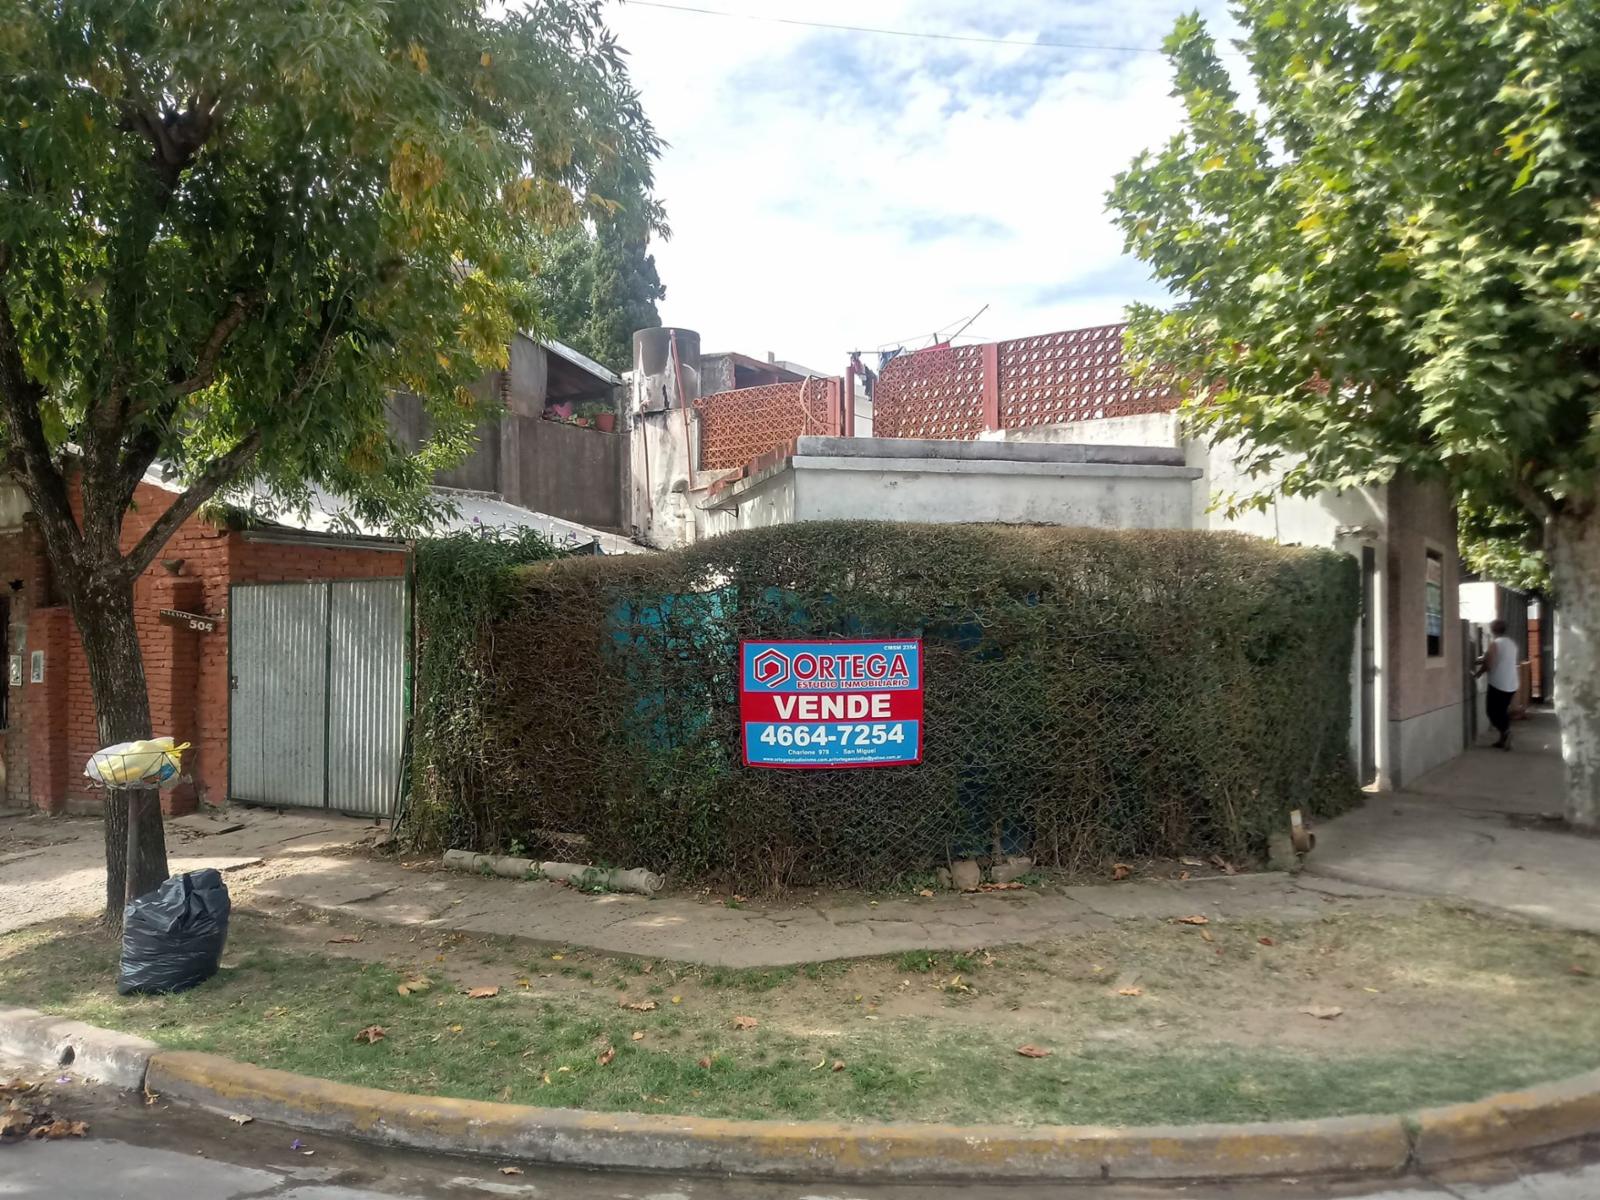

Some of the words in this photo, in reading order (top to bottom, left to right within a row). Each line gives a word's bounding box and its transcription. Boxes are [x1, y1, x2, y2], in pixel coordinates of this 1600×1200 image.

[189, 619, 213, 632] 504
[793, 652, 910, 680] ORTEGA
[796, 680, 838, 689] ESTUDIO
[840, 679, 909, 689] INMOBILIARIO
[773, 693, 892, 720] VENDE
[760, 723, 905, 747] 4664-7254
[856, 747, 877, 756] Miguel
